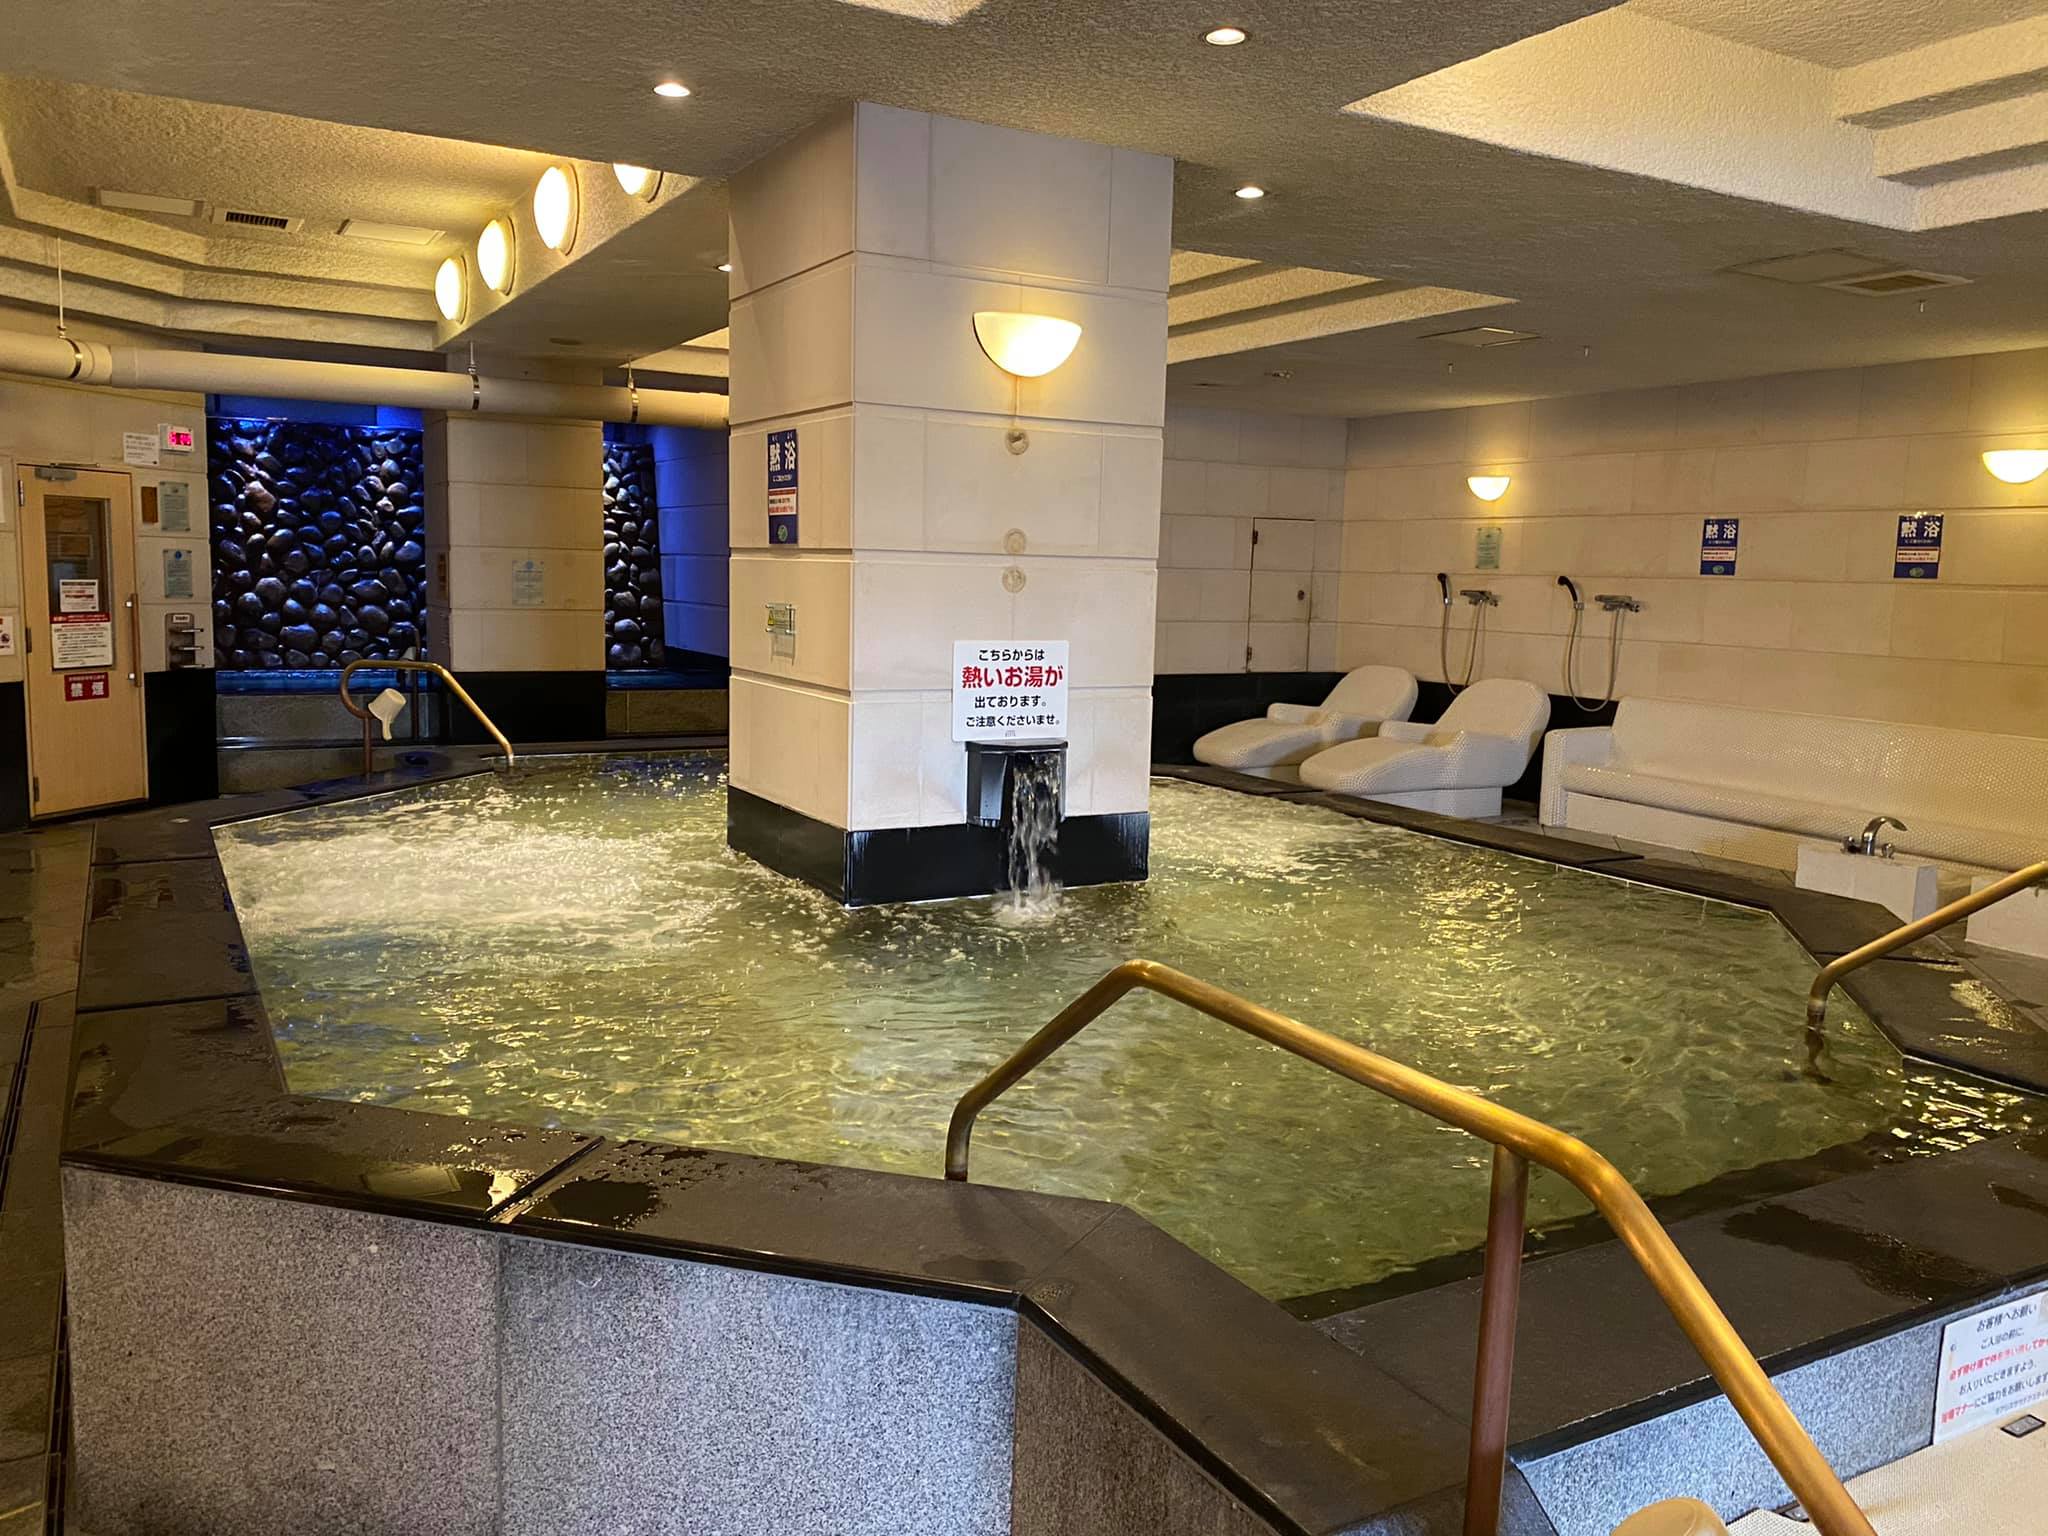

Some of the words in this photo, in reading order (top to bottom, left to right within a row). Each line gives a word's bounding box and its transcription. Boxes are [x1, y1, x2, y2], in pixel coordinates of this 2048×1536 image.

[978, 649, 1046, 662] こちらからは
[961, 665, 1064, 689] 熱いお湯が
[974, 695, 1047, 709] 出ております。
[966, 714, 1060, 727] ご注意くださいませ。
